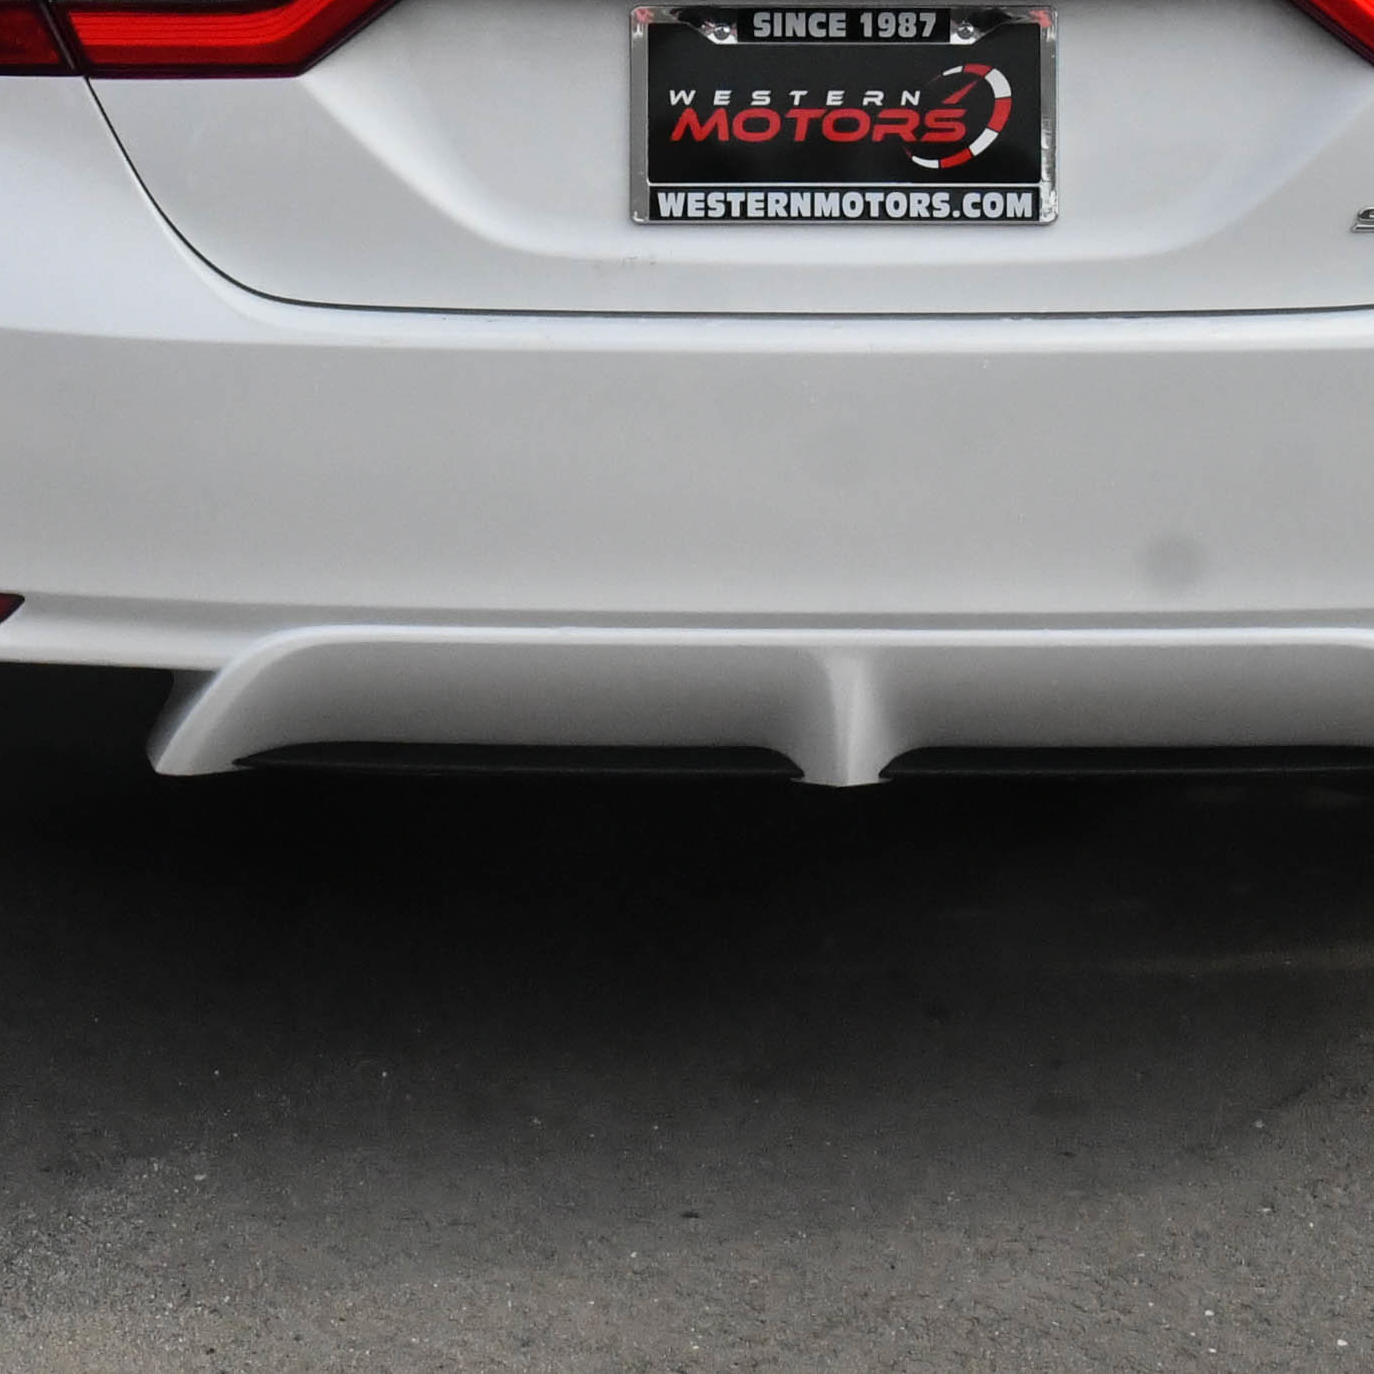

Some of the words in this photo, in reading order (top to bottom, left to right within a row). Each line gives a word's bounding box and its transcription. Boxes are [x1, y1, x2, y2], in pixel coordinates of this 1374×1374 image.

[753, 11, 846, 38] SINCE
[860, 11, 937, 38] 1987
[669, 89, 921, 106] WESTERN
[671, 107, 967, 142] MOTORS
[657, 191, 1033, 218] WESTERNMOTORS.COM
